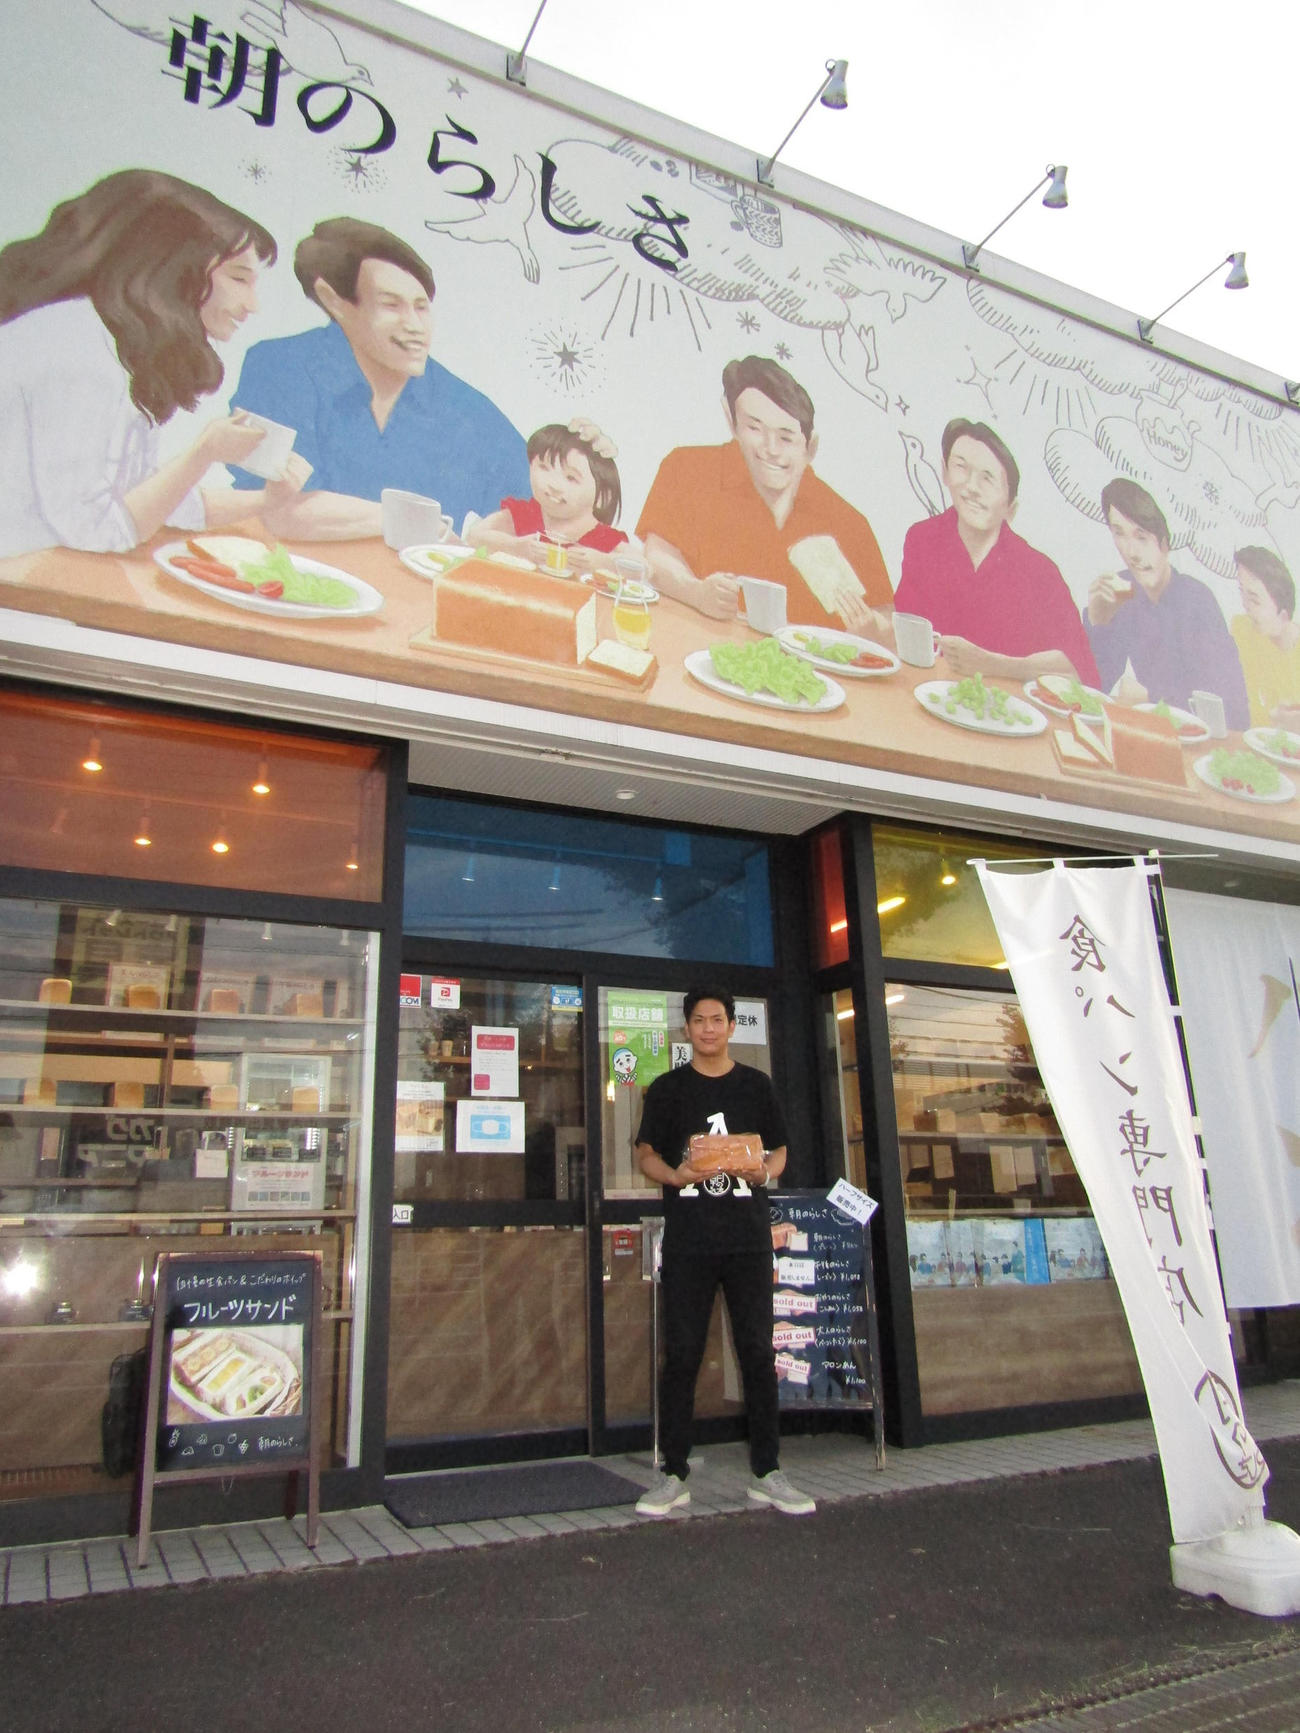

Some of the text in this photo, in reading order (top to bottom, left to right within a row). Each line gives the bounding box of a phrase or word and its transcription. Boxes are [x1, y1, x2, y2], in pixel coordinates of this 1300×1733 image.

[161, 13, 690, 271] 朝のらしさ
[1147, 429, 1188, 462] Honey
[735, 1014, 758, 1027] 定休
[838, 1182, 875, 1209] ハーフサイズ
[788, 1207, 828, 1220] 朝のらしさ
[184, 1294, 298, 1323] フルーツサンド
[773, 1298, 814, 1309] sold out
[795, 1331, 812, 1340] out
[776, 1359, 808, 1372] sold out
